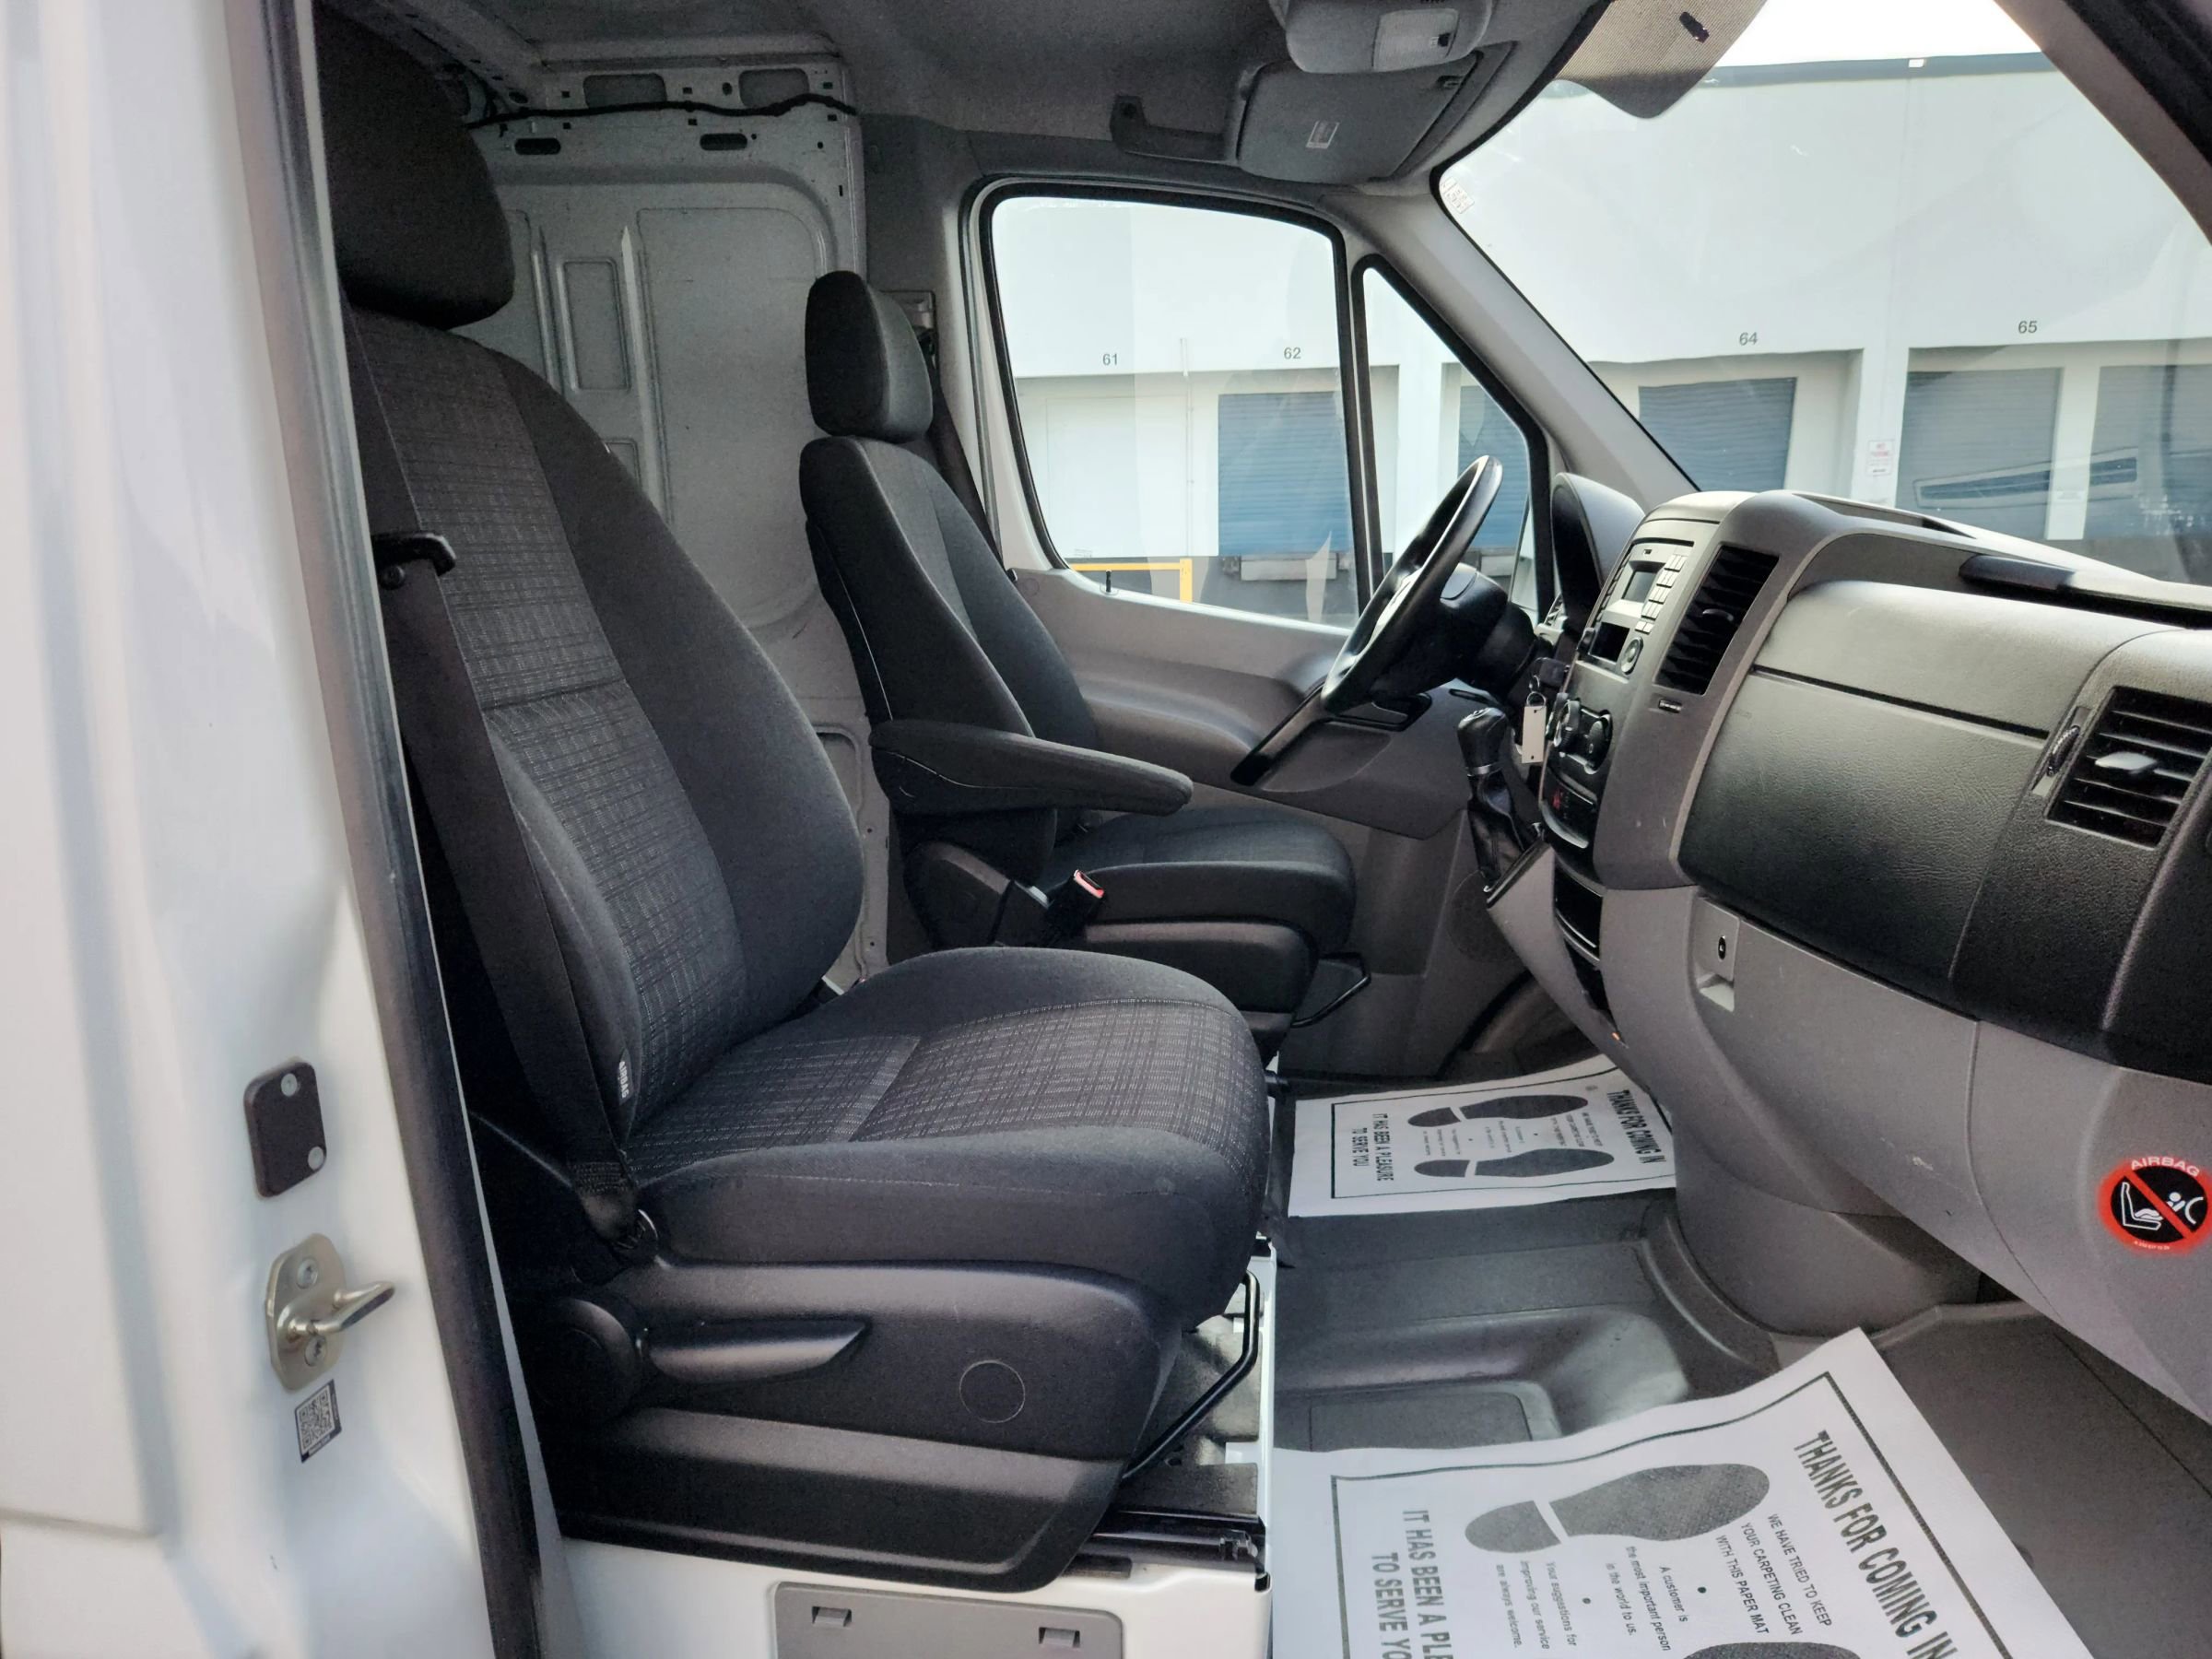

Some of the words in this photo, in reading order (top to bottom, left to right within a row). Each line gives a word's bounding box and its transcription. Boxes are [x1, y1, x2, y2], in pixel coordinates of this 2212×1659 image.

[1739, 331, 1758, 346] 64
[2018, 320, 2038, 334] 65
[1102, 353, 1118, 366] 61
[1283, 347, 1301, 359] 62
[2131, 1156, 2200, 1177] AIRBAG
[1794, 1429, 1863, 1509] THANKS
[1403, 1510, 1430, 1523] IT
[1768, 1513, 1783, 1529] WE
[1832, 1502, 1888, 1553] FOR
[1406, 1528, 1437, 1560] HAS
[1626, 1546, 1637, 1559] the
[1775, 1529, 1796, 1556] HAVE
[1371, 1552, 1401, 1573] TO
[1496, 1564, 1506, 1577] are
[1546, 1561, 1558, 1581] Your
[1630, 1560, 1646, 1582] most
[1788, 1556, 1810, 1583] TRIED
[1410, 1565, 1445, 1606] BEEN
[1609, 1571, 1620, 1584] the
[1715, 1535, 1734, 1558] WITH
[1726, 1558, 1744, 1579] THIS
[1735, 1580, 1759, 1612] PAPER
[1749, 1613, 1770, 1634] MAT
[1741, 1522, 1760, 1547] YOUR
[1753, 1548, 1786, 1601] CARPETING
[1779, 1602, 1804, 1635] CLEAN
[1500, 1580, 1513, 1606] always
[1614, 1584, 1628, 1609] world
[1639, 1582, 1661, 1620] important
[1662, 1574, 1686, 1613] customer
[1678, 1614, 1688, 1623] is
[1804, 1583, 1818, 1599] TO
[1858, 1547, 1937, 1638] COMING
[1374, 1578, 1409, 1631] SERVE
[1531, 1601, 1542, 1618] our
[1550, 1582, 1572, 1631] suggestions
[1621, 1609, 1632, 1621] to
[1810, 1599, 1832, 1627] KEEP
[1418, 1613, 1447, 1626] A
[1507, 1609, 1523, 1648] welcome.
[1626, 1623, 1638, 1636] us.
[1535, 1618, 1550, 1650] service
[1566, 1633, 1578, 1647] for
[1650, 1620, 1672, 1652] person
